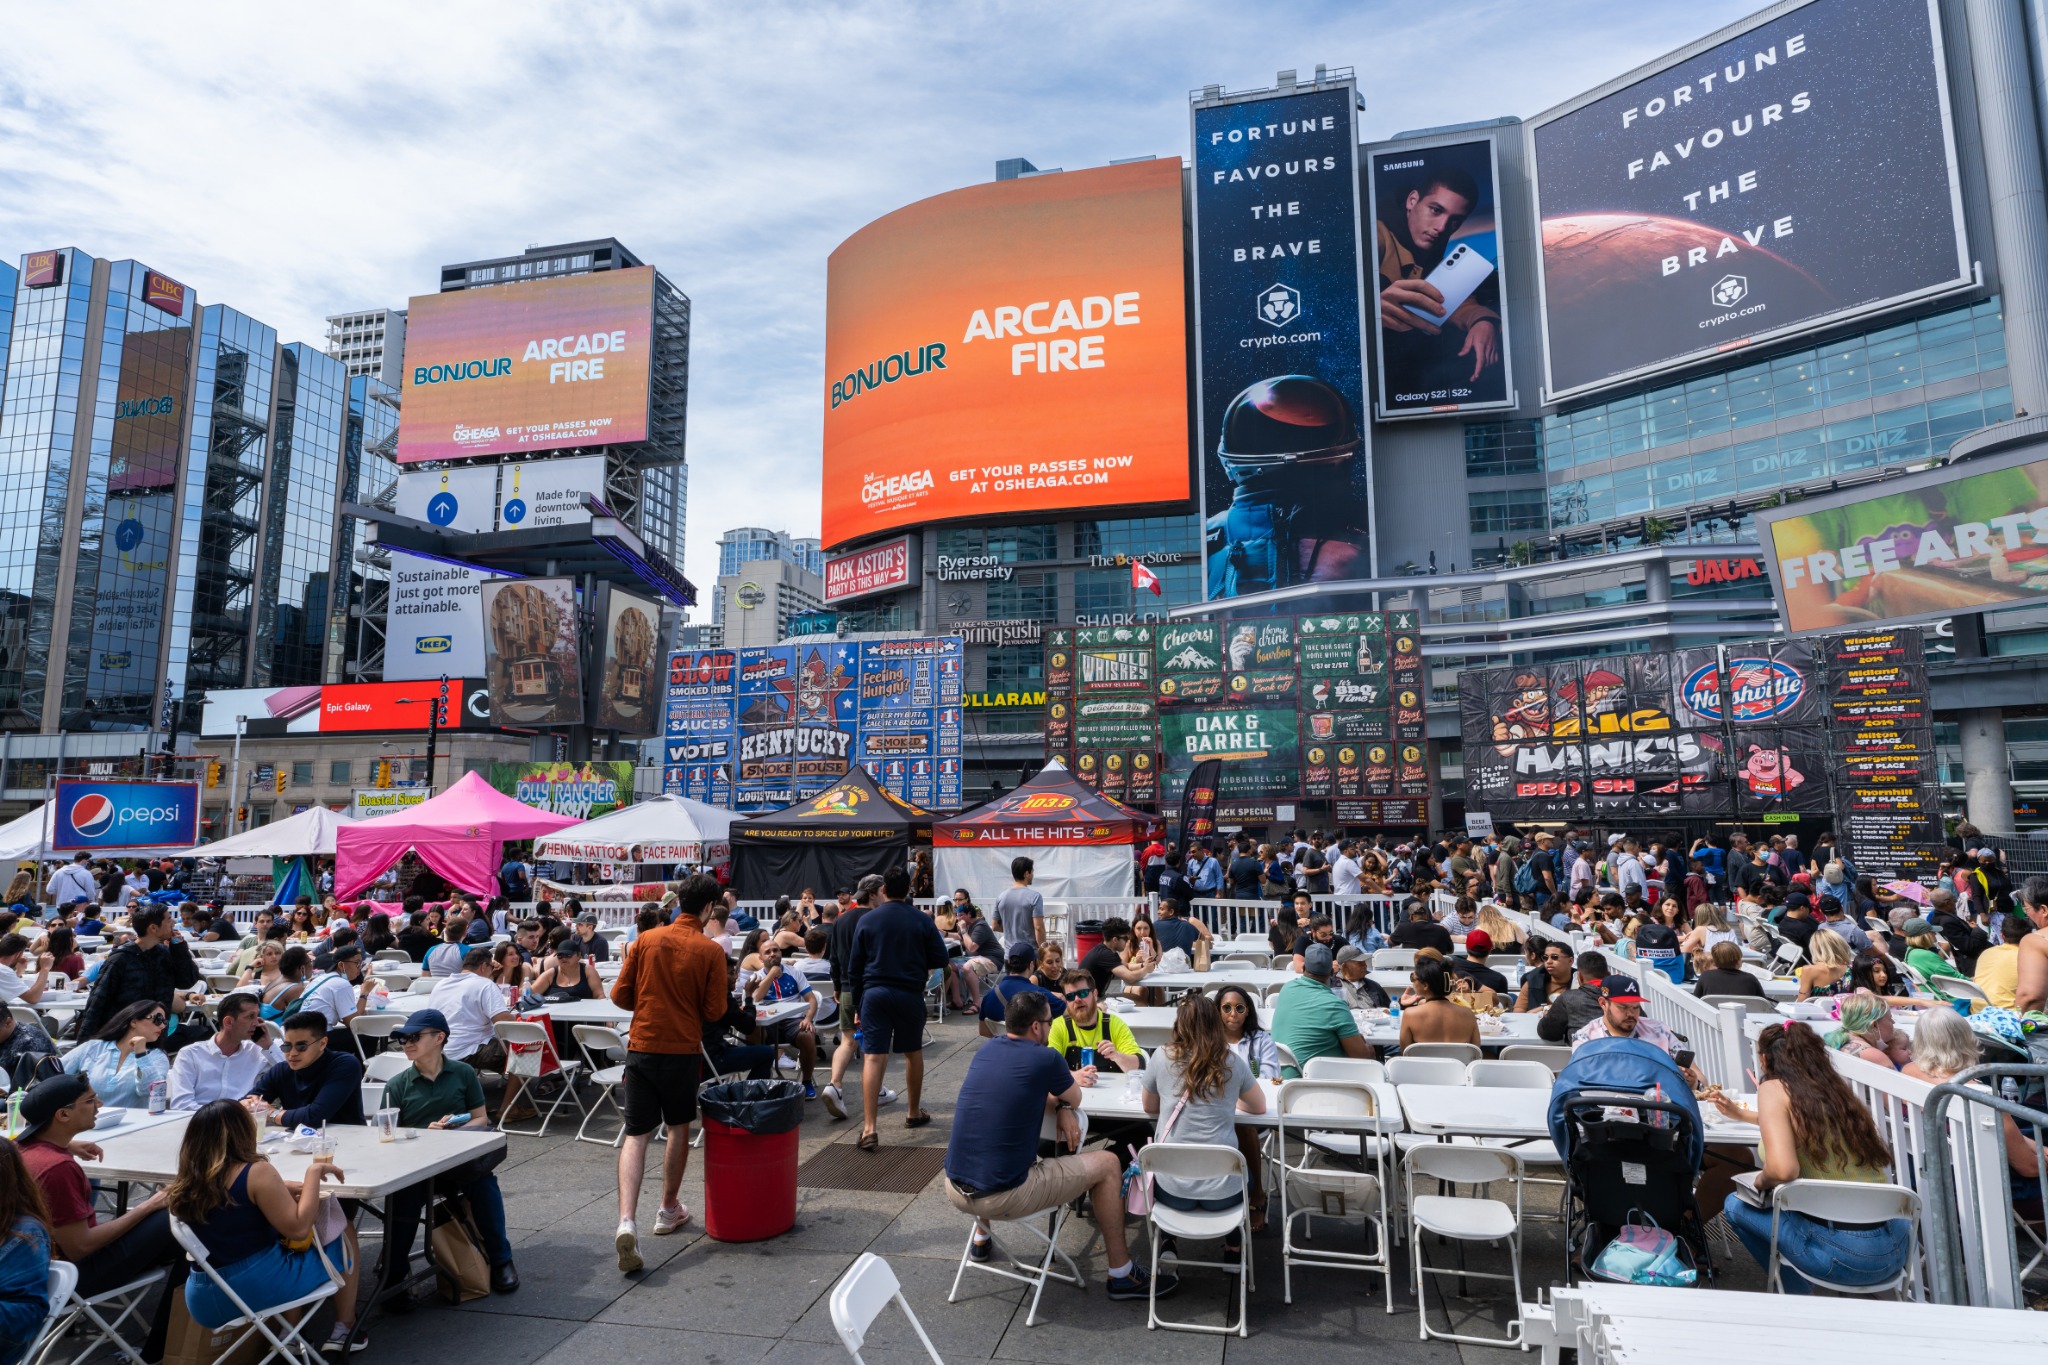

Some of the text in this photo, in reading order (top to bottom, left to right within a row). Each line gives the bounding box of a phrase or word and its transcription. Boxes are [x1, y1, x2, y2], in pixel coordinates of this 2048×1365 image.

[1621, 33, 1807, 130] FORTUNE
[1211, 116, 1335, 146] FORTUNE
[1626, 90, 1812, 180] FAVOURS
[1213, 156, 1336, 185] FAVOURS
[1383, 159, 1424, 172] SAMSUNG
[1682, 169, 1758, 212] THE
[1250, 201, 1301, 220] THE
[1233, 239, 1321, 262] BRAVE
[1661, 214, 1795, 278] BRAVE
[28, 254, 54, 269] CIBC
[152, 275, 183, 299] CIBC
[962, 291, 1140, 344] ARCADE
[1698, 301, 1766, 329] crypto.com
[521, 330, 626, 363] ARCADE
[1239, 330, 1321, 349] crypto.com
[1011, 335, 1106, 376] FIRE
[413, 357, 513, 386] BONJOUR
[550, 358, 605, 384] FIRE
[831, 341, 947, 411] BONJOUR
[1395, 388, 1473, 402] Galaxy S22 S22+
[453, 426, 501, 442] OSHEAGA
[506, 417, 612, 435] GET YOUR PASSES NOW
[518, 428, 598, 443] AT OSHEAGA.COM
[1845, 427, 1907, 456] DMZ
[949, 455, 1133, 482] GET YOUR PASSES NOW
[1752, 447, 1807, 474] DMZ
[862, 469, 935, 503] OSHEAGA
[970, 471, 1108, 493] AT OSHEAGA.COM
[1668, 468, 1717, 491] DMZ
[536, 488, 580, 501] Made for
[534, 513, 565, 526] living.
[1781, 507, 2048, 590] FREE ARTS
[828, 545, 905, 585] JACK ASTOR'S
[938, 555, 998, 570] Ryerson
[1088, 551, 1182, 567] The Beer Store
[396, 568, 470, 583] Sustainable
[938, 566, 1013, 580] University
[1687, 557, 1761, 586] JACK
[828, 581, 849, 597] PARTY
[850, 580, 856, 591] IS
[857, 575, 873, 590] THIS
[873, 571, 890, 585] WAY
[396, 584, 480, 602] just got more
[395, 599, 462, 615] attainable.
[981, 619, 1025, 627] RESTAURANT
[1075, 613, 1136, 627] SHARK
[1004, 619, 1041, 639] sushi
[418, 640, 448, 649] IKEA
[1163, 628, 1214, 651] Cheers!
[1258, 628, 1289, 648] drink
[1334, 642, 1352, 650] SAUCE
[1843, 635, 1895, 645] Windsor
[1862, 642, 1892, 650] PLACE
[880, 647, 944, 656] CHICKEN
[1118, 652, 1148, 666] OLD
[1256, 647, 1292, 664] bourbon
[671, 653, 734, 684] SLOW
[742, 666, 786, 681] CHOICE
[863, 667, 904, 684] Feeling
[1083, 654, 1149, 682] WHISKEY
[1848, 667, 1899, 677] Midland
[669, 685, 732, 696] SMOKED RIBS
[863, 678, 910, 699] Hungry?
[1334, 684, 1373, 696] BBQ
[1338, 691, 1378, 703] Time!
[1690, 676, 1802, 711] Nashville
[962, 691, 1046, 707] OLLARAM
[326, 702, 372, 714] Epic Galaxy.
[671, 719, 727, 731] SAUCES
[1195, 714, 1259, 732] OAK &
[1552, 709, 1671, 742] BIG
[669, 741, 727, 760] VOTE
[741, 728, 850, 761] KENTUCKY
[1186, 732, 1272, 753] BARREL
[1515, 733, 1700, 774] HANK'S
[1846, 755, 1919, 763] Georgetown
[89, 763, 113, 775] MUJI
[747, 762, 843, 776] SMOKE HOUSE
[513, 782, 615, 801] JOLLY RANCHER
[737, 790, 792, 802] LOUISVILLE
[1516, 781, 1581, 797] BBQ
[1855, 788, 1913, 796] Thornhill
[358, 793, 426, 806] Roasted Sweet
[1547, 801, 1678, 810] NASHVILLE
[118, 803, 180, 826] pepsi
[365, 807, 384, 816] Corn
[1162, 810, 1178, 818] THE
[1238, 807, 1274, 816] SPECIAL
[744, 829, 760, 837] ARE
[873, 830, 895, 838] LIFE?
[979, 827, 1085, 841] ALL THE HITS
[547, 843, 582, 857] HENNA
[643, 845, 666, 859] FACE
